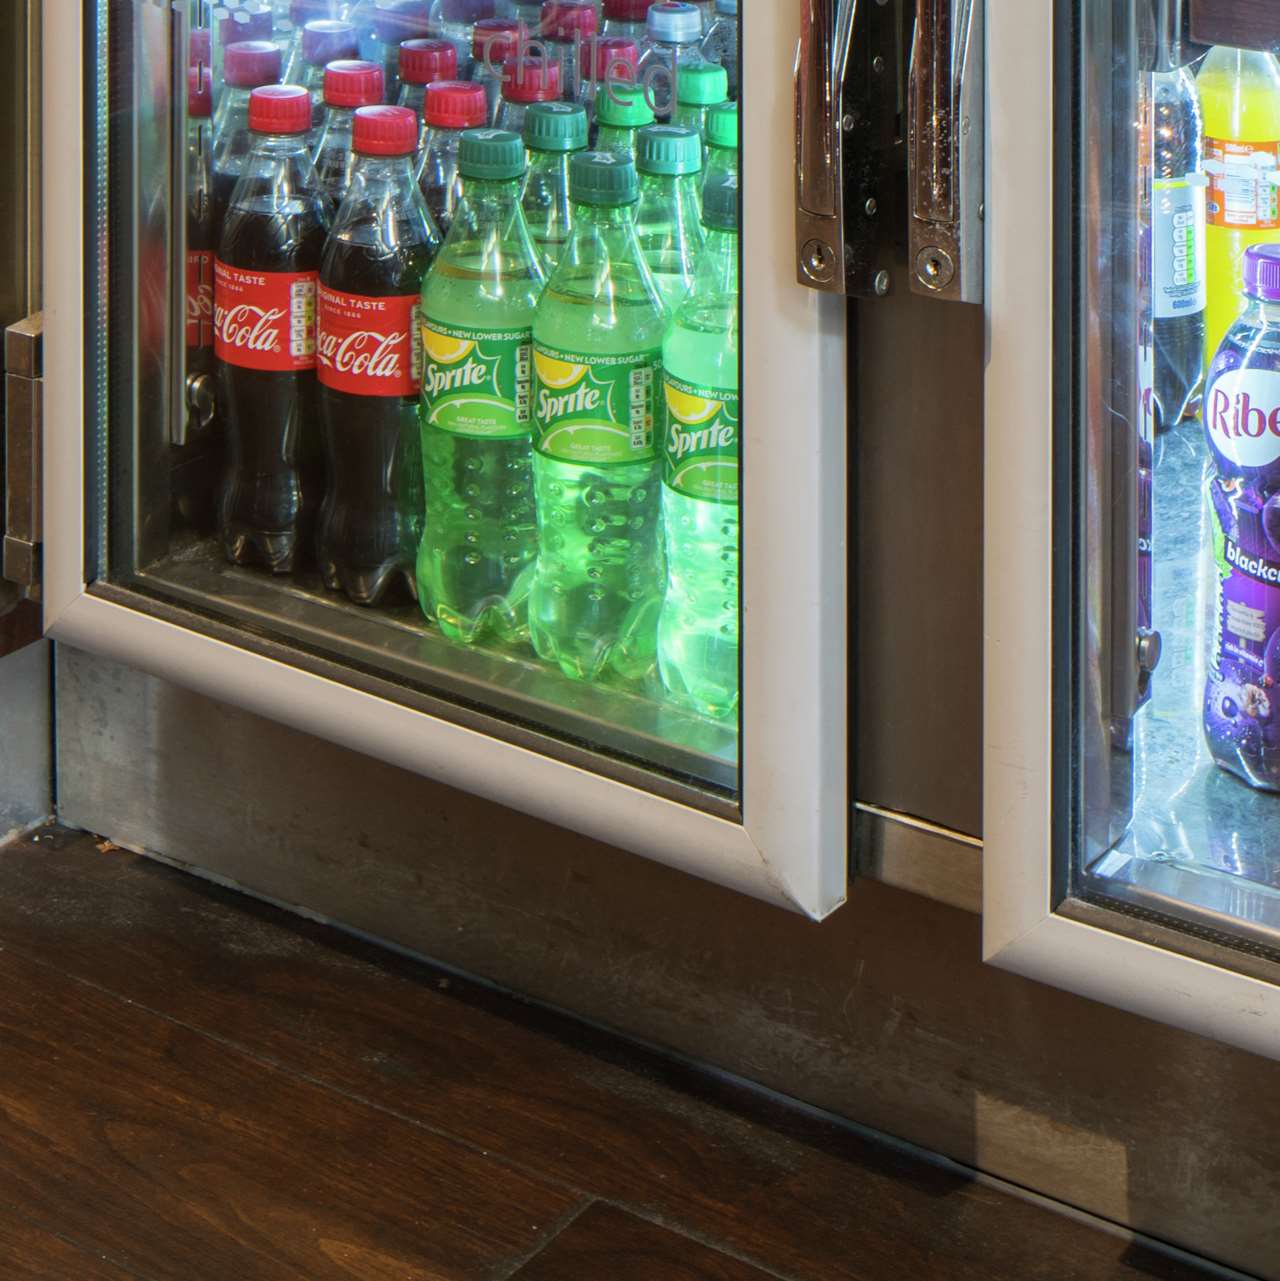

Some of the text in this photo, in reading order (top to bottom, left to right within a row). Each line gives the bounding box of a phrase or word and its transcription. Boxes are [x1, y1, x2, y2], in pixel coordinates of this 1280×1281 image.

[483, 17, 678, 118] chilled
[233, 273, 266, 285] TASTE
[349, 299, 386, 311] TASTE
[452, 330, 471, 339] NEW
[472, 332, 504, 340] LOWER
[564, 354, 616, 365] NEW LOWER
[425, 357, 488, 397] Sprite
[698, 389, 719, 399] NEW
[537, 381, 600, 424] Sprite
[668, 417, 735, 460] Sprite
